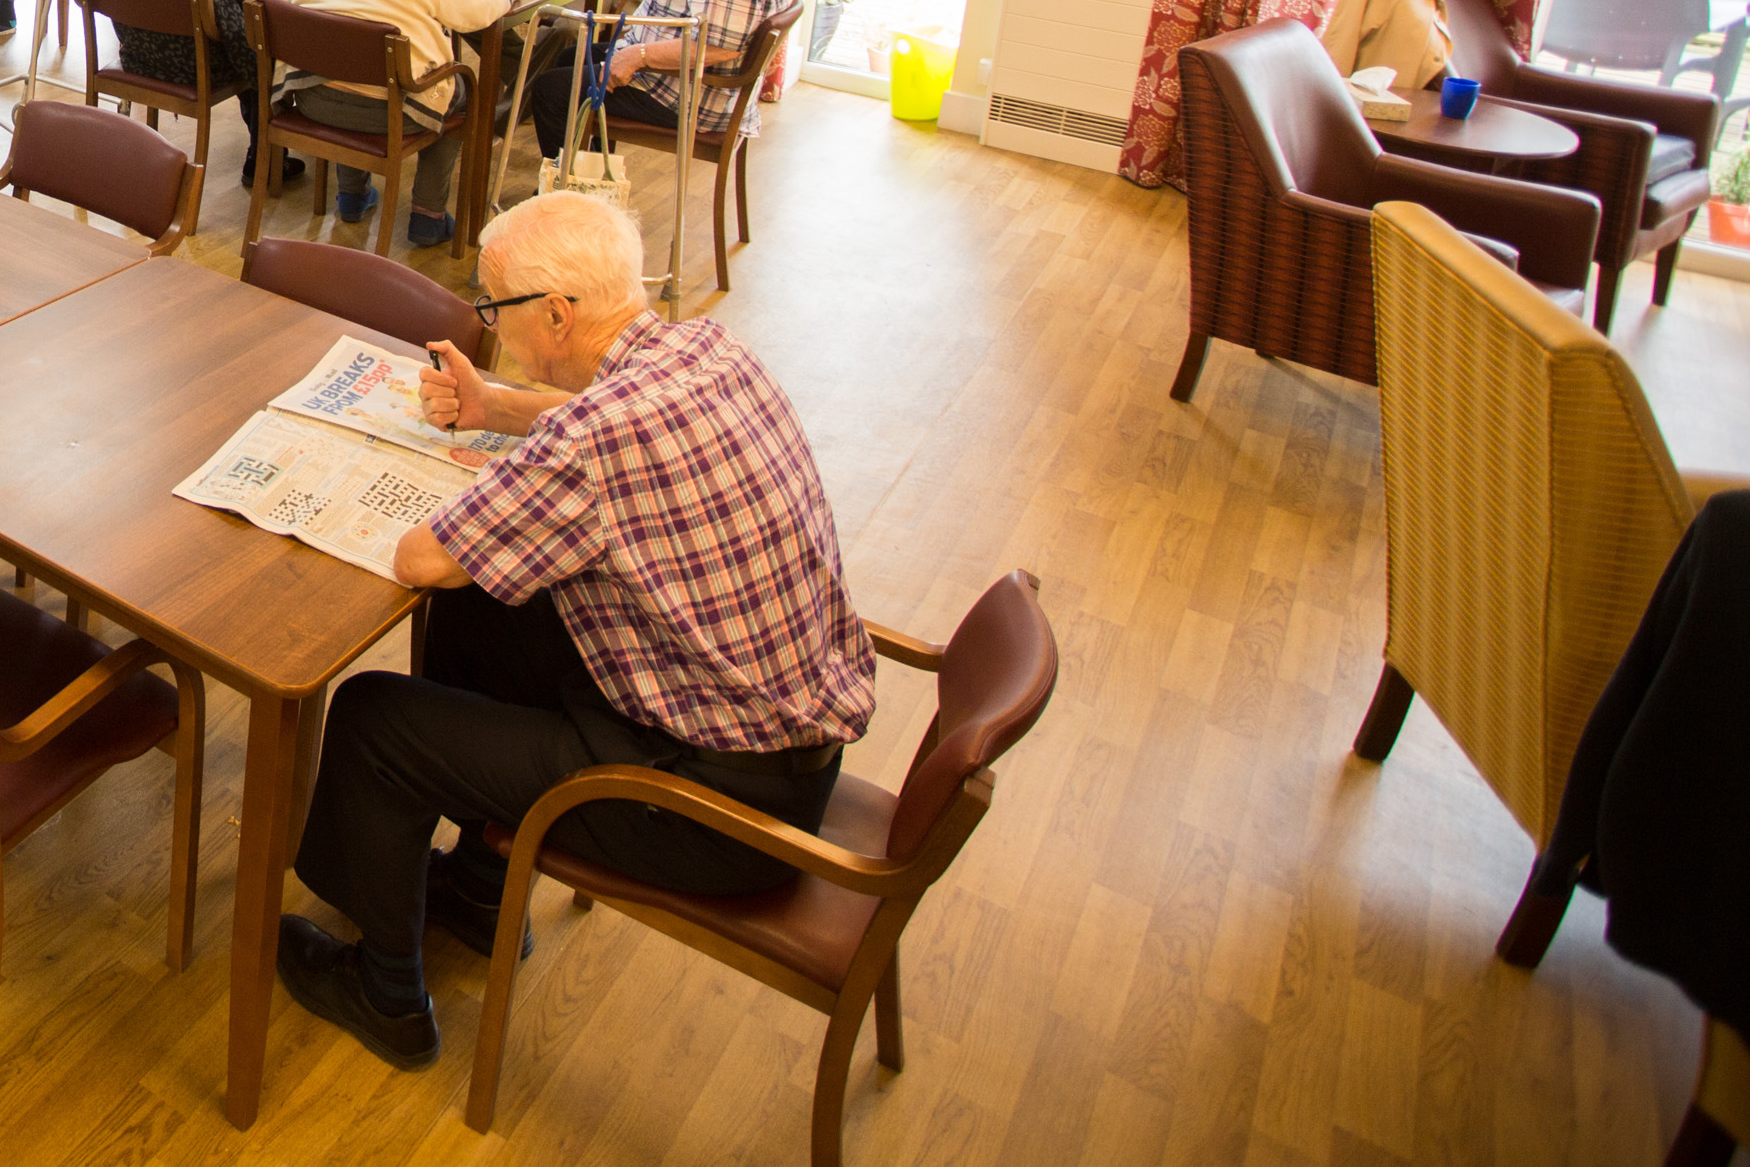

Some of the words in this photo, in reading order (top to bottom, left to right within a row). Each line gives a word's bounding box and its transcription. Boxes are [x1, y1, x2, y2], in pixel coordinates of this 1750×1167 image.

[302, 396, 330, 410] UK
[320, 352, 375, 400] BREAKS
[322, 392, 364, 415] FROM
[468, 438, 488, 452] 170
[485, 444, 500, 452] to
